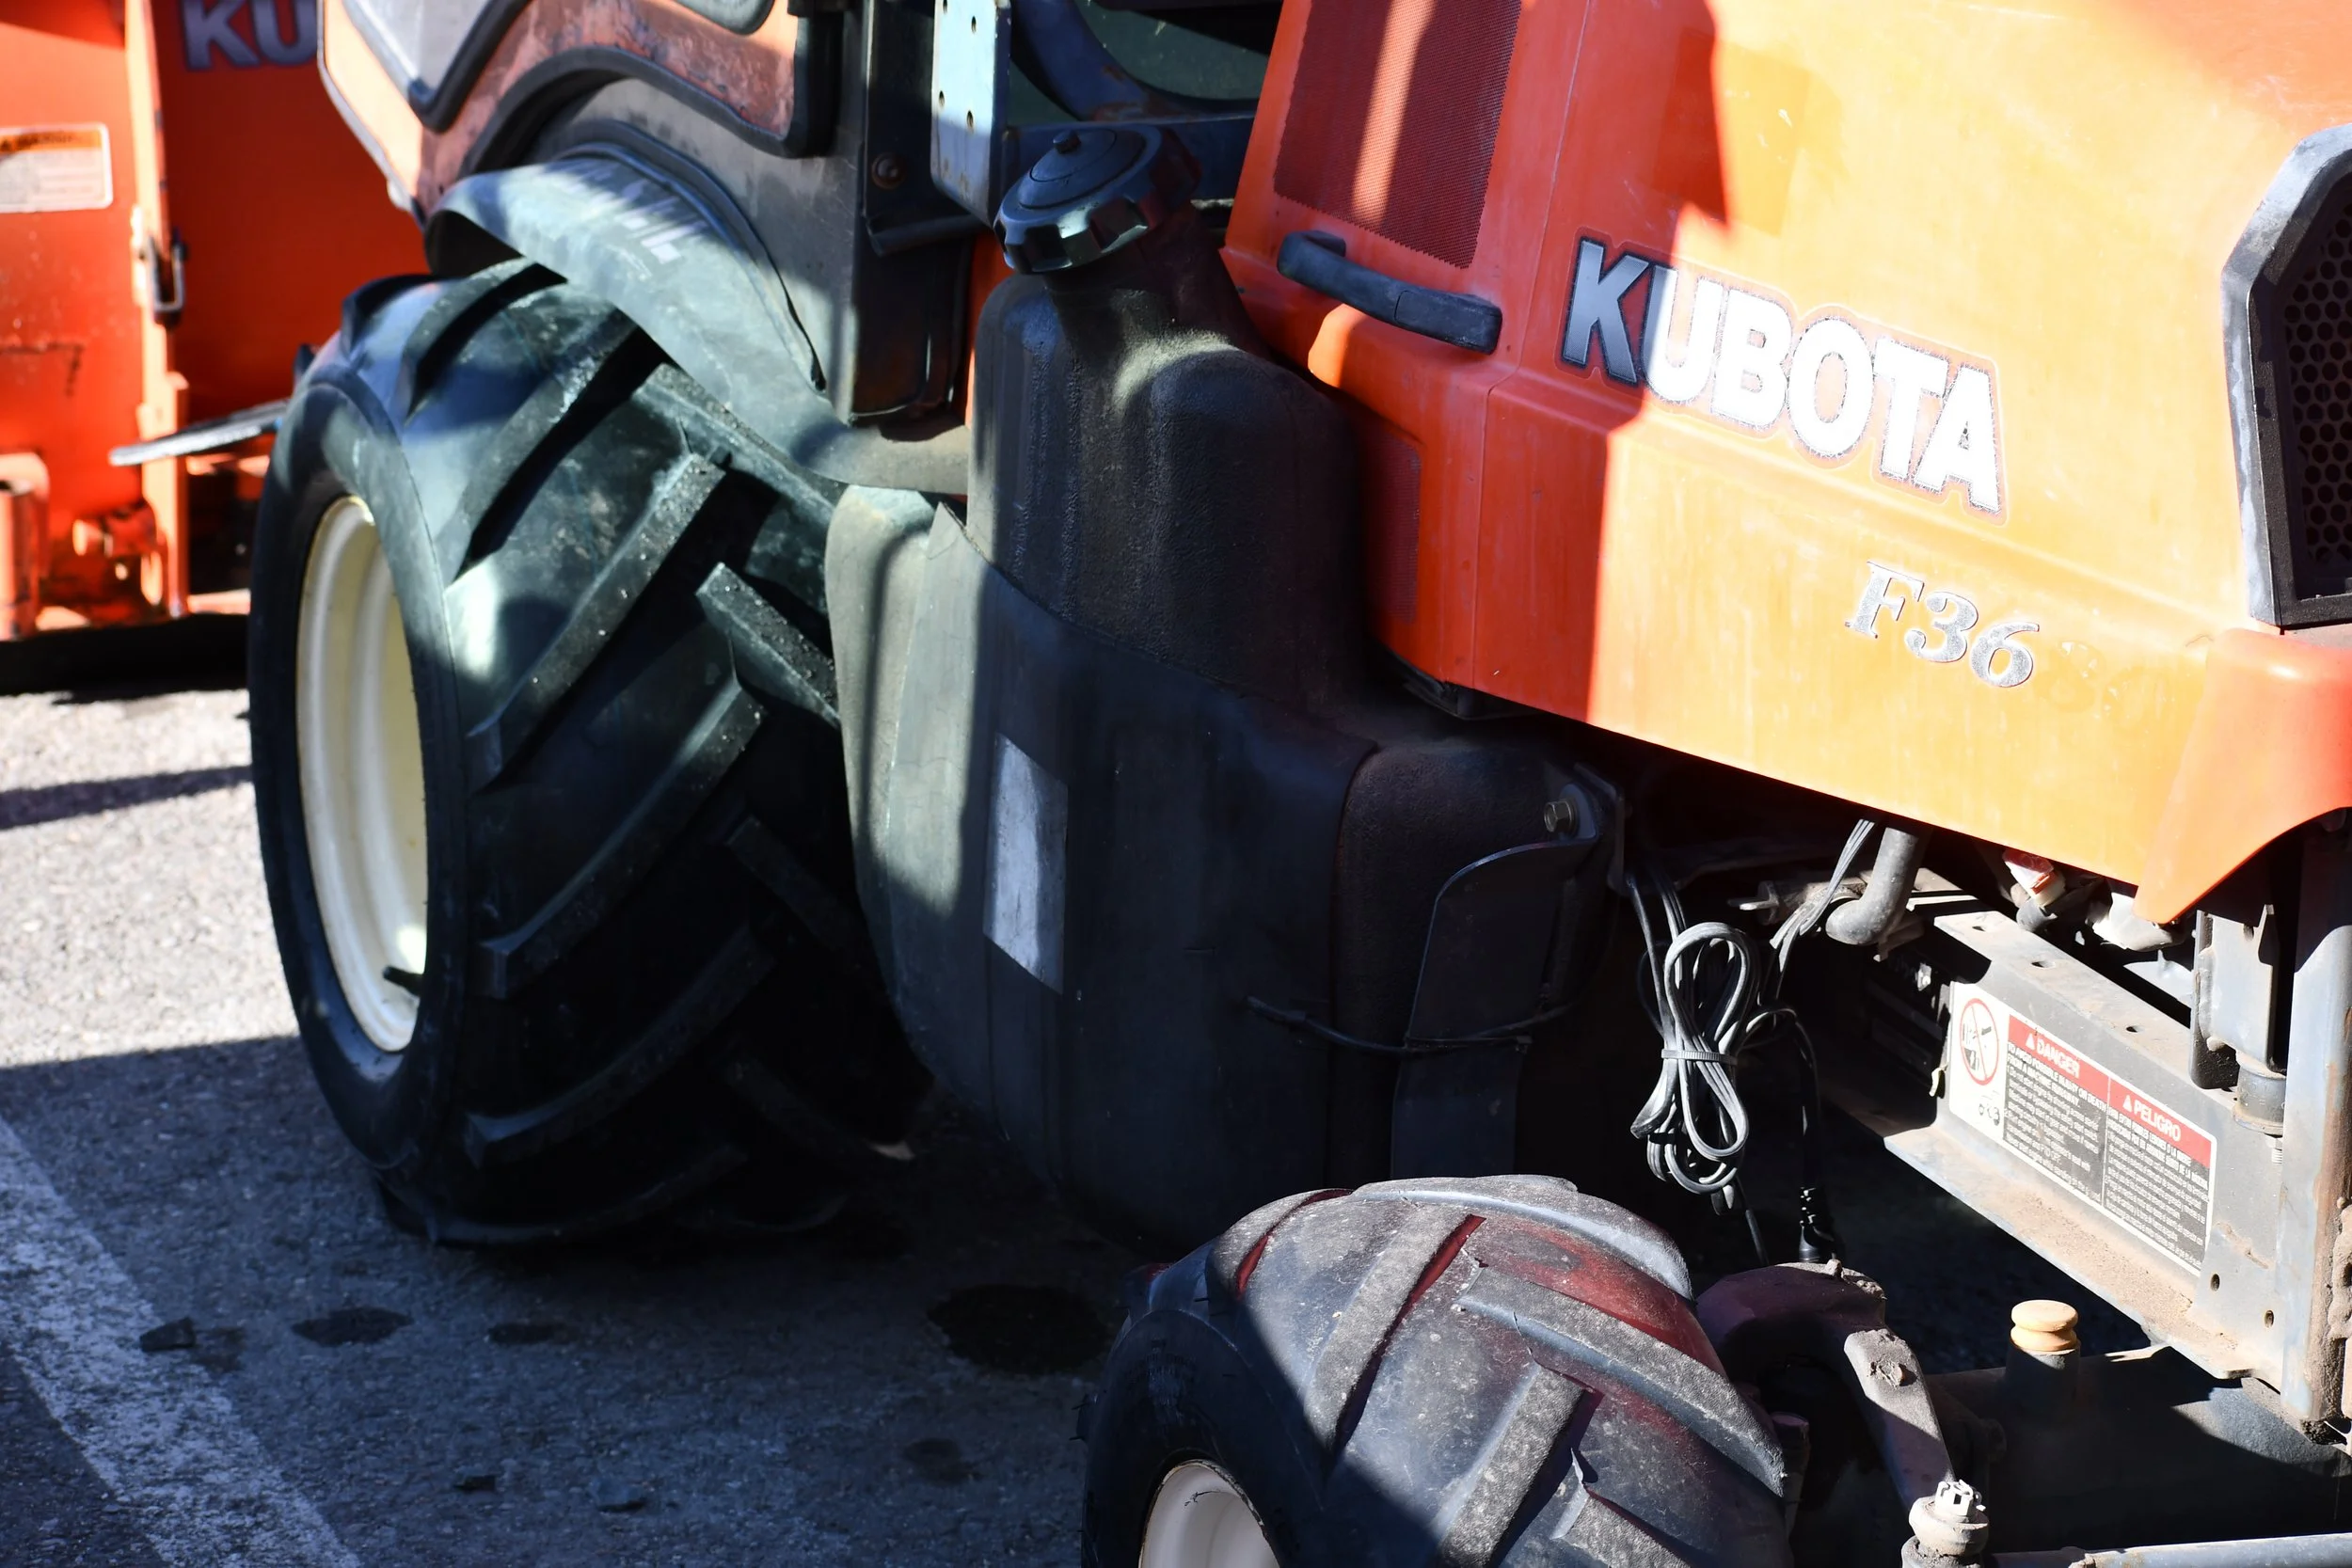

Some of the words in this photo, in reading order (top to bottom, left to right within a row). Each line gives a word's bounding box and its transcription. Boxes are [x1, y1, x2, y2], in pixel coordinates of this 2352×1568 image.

[1561, 236, 2001, 515] KUBOTA
[1844, 561, 2040, 689] F36
[2037, 1038, 2081, 1079] DANGER
[2134, 1100, 2181, 1142] PELIGRO
